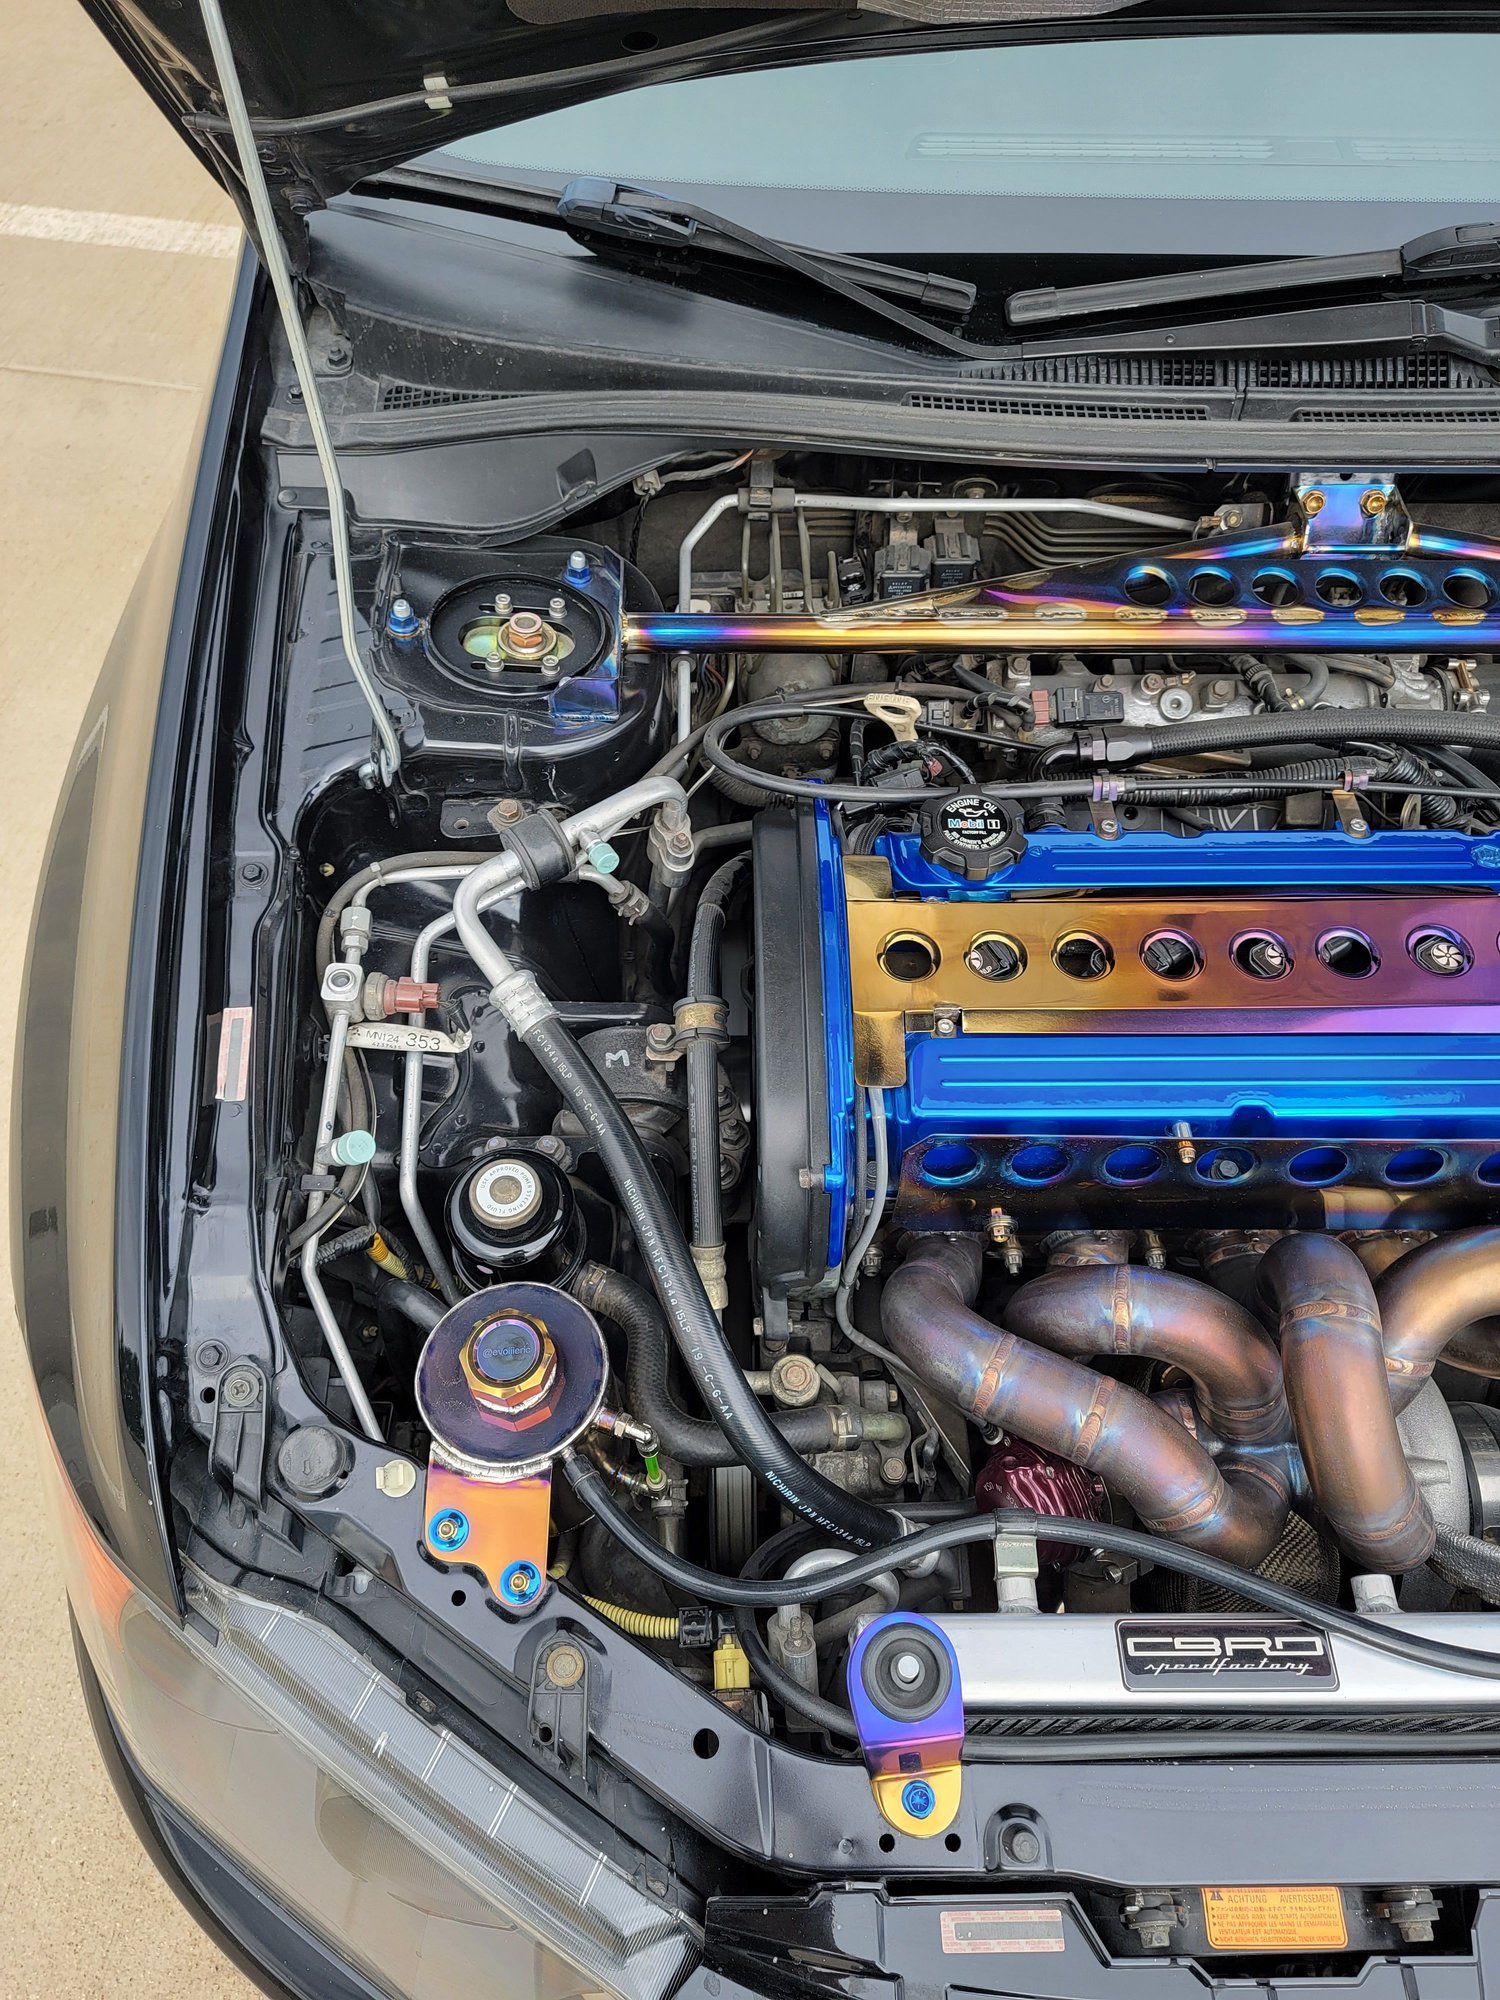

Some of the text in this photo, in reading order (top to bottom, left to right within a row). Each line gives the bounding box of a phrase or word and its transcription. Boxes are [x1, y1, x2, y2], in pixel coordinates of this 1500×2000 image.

[946, 799, 997, 813] ENGINE OIL
[948, 818, 984, 829] Mobil
[953, 839, 979, 849] SYNTHETIC
[366, 1030, 441, 1051] MN124 353
[480, 1166, 532, 1214] USE APPROVED POWER STEERING FLUID
[623, 1178, 646, 1222] NICHIRIN
[642, 1224, 656, 1247] JPN
[765, 1470, 800, 1504] NICHIRIN
[798, 1505, 817, 1518] JPN
[1143, 1657, 1314, 1676] speedfactory
[1228, 1893, 1335, 1904] ACHTUNG AVERTISSEMENT
